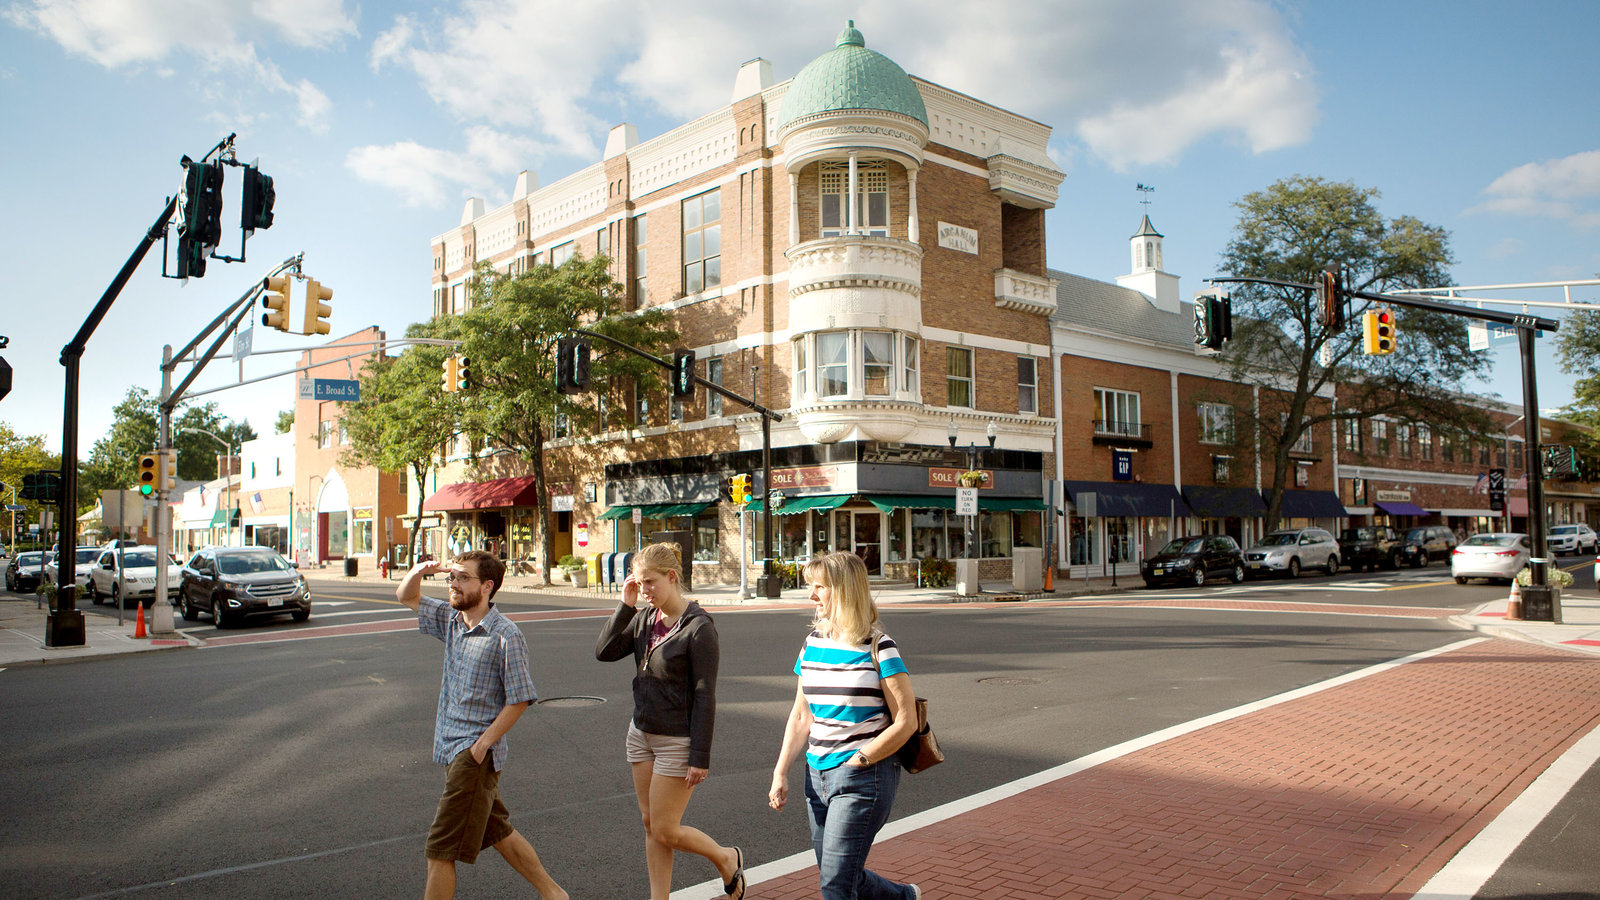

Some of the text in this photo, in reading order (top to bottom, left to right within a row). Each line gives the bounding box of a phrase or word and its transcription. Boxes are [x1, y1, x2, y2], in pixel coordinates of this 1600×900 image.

[948, 237, 969, 251] HALL
[1494, 326, 1517, 339] Elm
[316, 384, 357, 396] E. Broad St.
[772, 474, 793, 484] SOLE
[932, 472, 953, 482] SOLE
